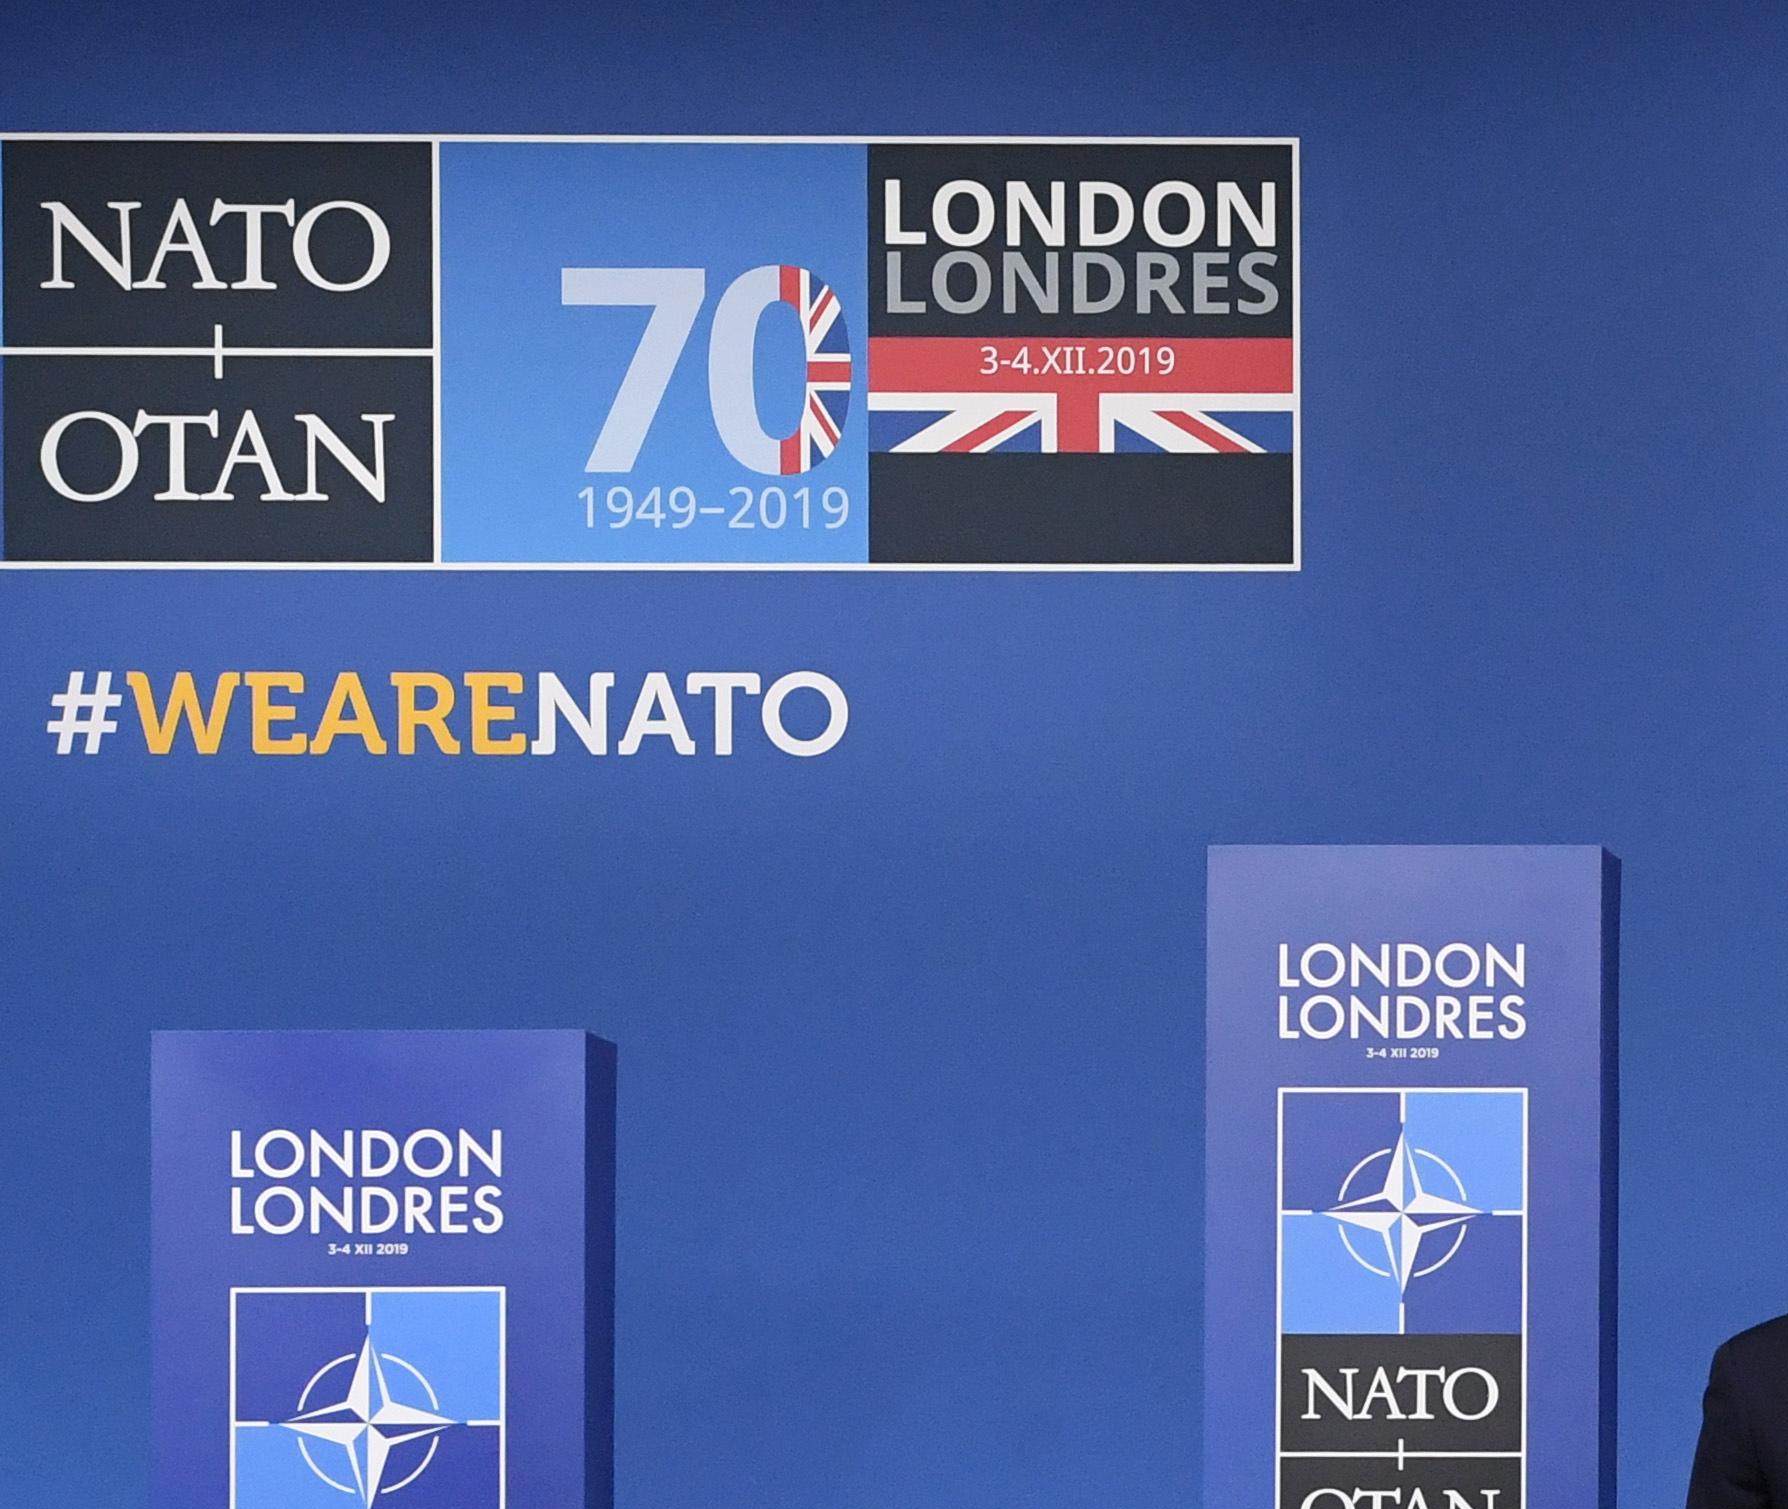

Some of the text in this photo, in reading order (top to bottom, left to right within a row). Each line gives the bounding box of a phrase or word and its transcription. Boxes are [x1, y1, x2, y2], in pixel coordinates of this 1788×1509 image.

[885, 180, 1275, 247] LONDON
[41, 198, 390, 291] NATO
[887, 251, 1278, 314] LONDRES
[562, 265, 852, 475] 70
[981, 346, 1174, 374] 3-4.XII.2019
[41, 409, 395, 502] OTAN
[47, 671, 848, 756] #WEARENATO
[1280, 943, 1524, 987] LONDON
[1280, 995, 1526, 1039] LONDRES
[1367, 1048, 1439, 1058] 3-4 XII 2019
[232, 1129, 501, 1178] LONDON
[232, 1185, 503, 1234] LONDRES
[328, 1244, 408, 1254] 3-4 XII 2019
[1301, 1367, 1498, 1420] NATO
